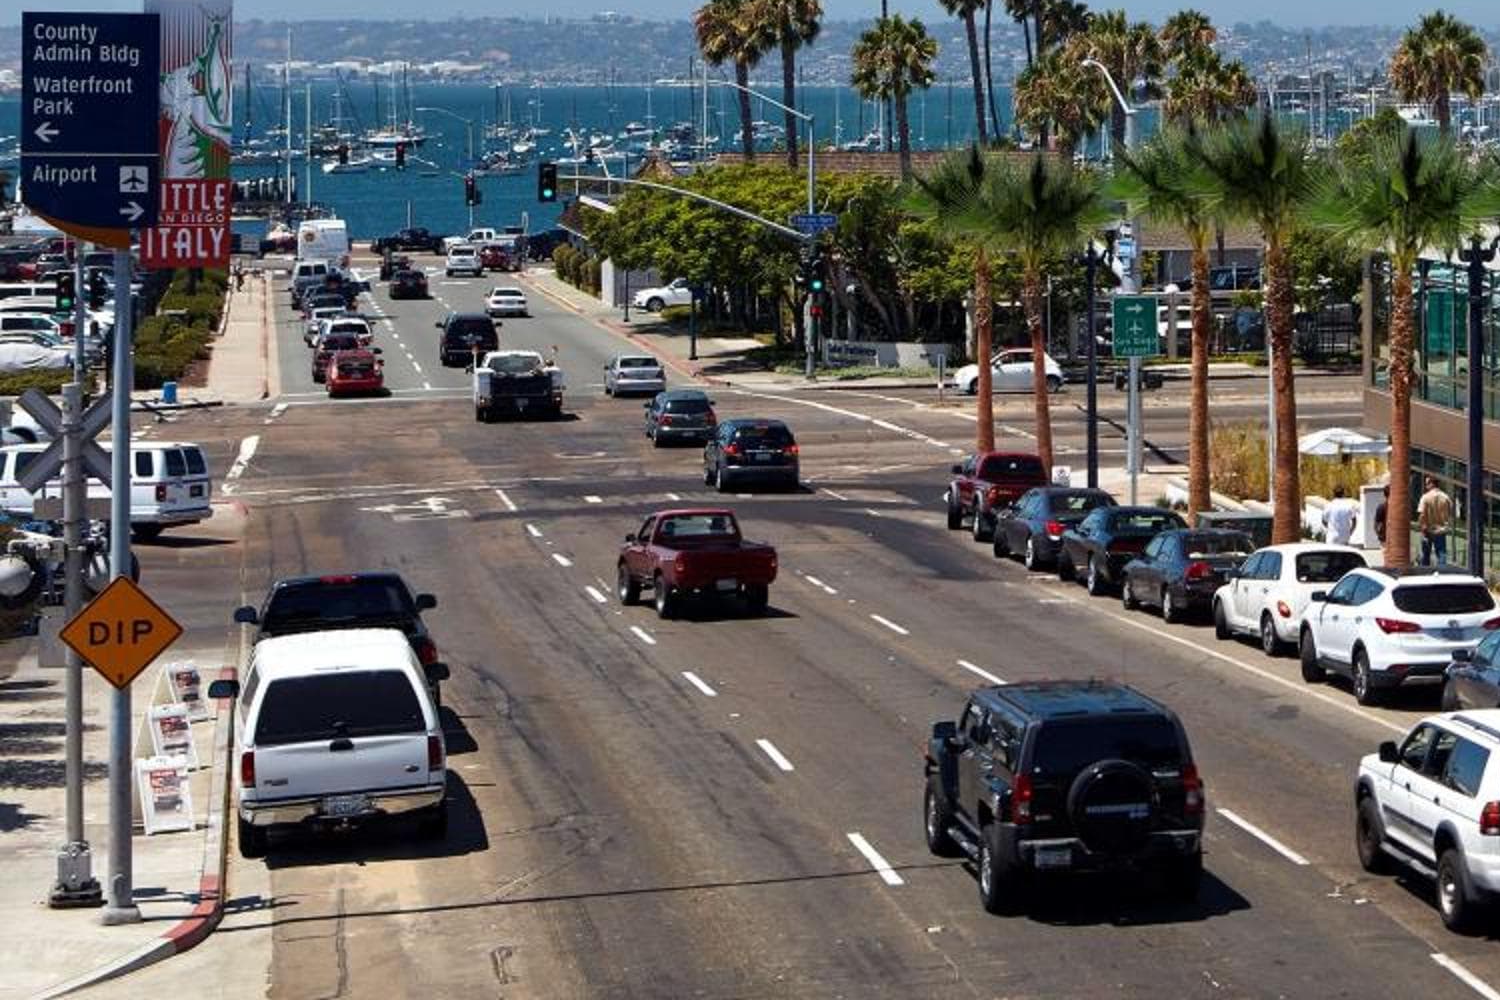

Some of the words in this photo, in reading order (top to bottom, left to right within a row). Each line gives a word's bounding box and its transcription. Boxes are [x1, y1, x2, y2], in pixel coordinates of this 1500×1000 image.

[33, 23, 97, 44] County
[33, 45, 91, 62] Admin
[100, 45, 140, 66] Bldg
[33, 77, 133, 94] Waterfront
[33, 98, 73, 115] Park
[32, 165, 97, 186] Airport
[161, 183, 226, 210] ITTLE
[181, 213, 225, 223] DIEGO
[147, 227, 225, 259] ITALY
[89, 620, 154, 645] DIP
